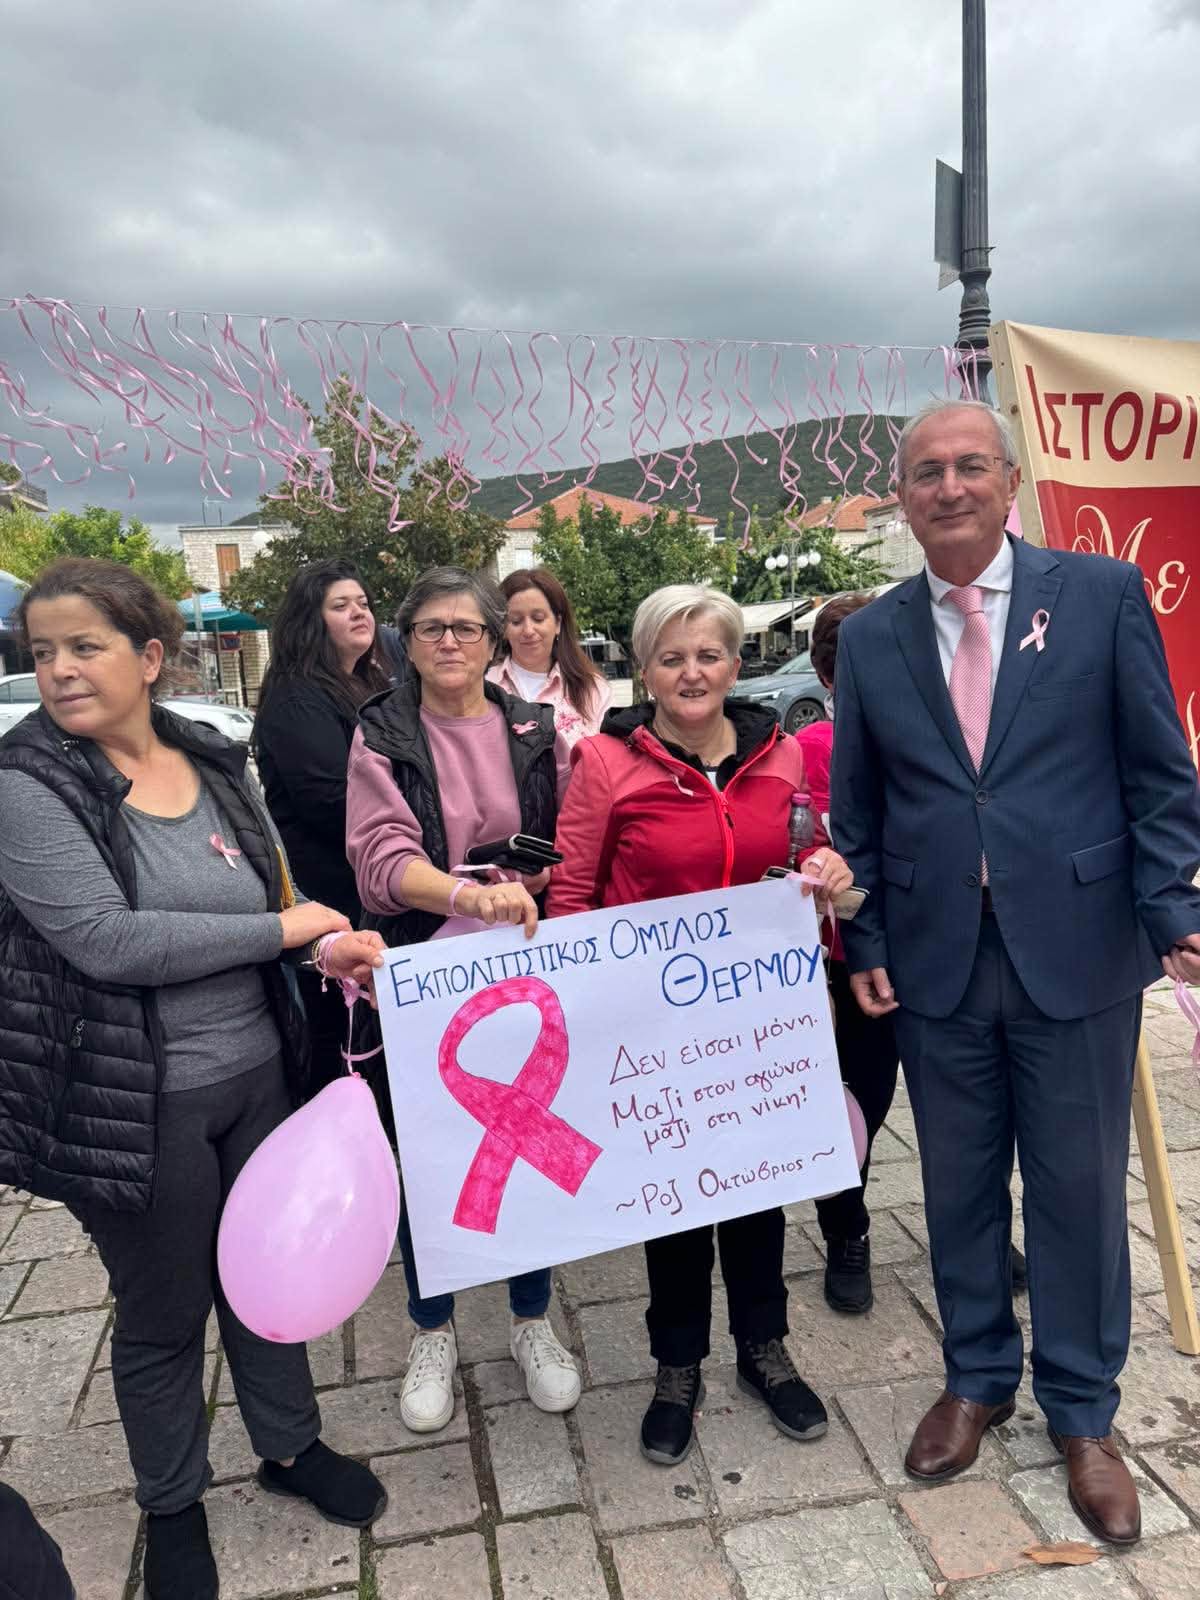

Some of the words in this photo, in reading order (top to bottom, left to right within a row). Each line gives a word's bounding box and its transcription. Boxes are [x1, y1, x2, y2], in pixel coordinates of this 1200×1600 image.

[390, 936, 602, 1008] ΕΚΠΟΛΙΤΙΣΤΙΚΟΣ
[609, 907, 732, 960] ΟΜΙΛΟΣ
[661, 943, 822, 1007] ΘΕΡΜΟΥ
[609, 1045, 666, 1085] Δεν
[680, 1035, 742, 1065] είσαι
[693, 1079, 736, 1102] στον
